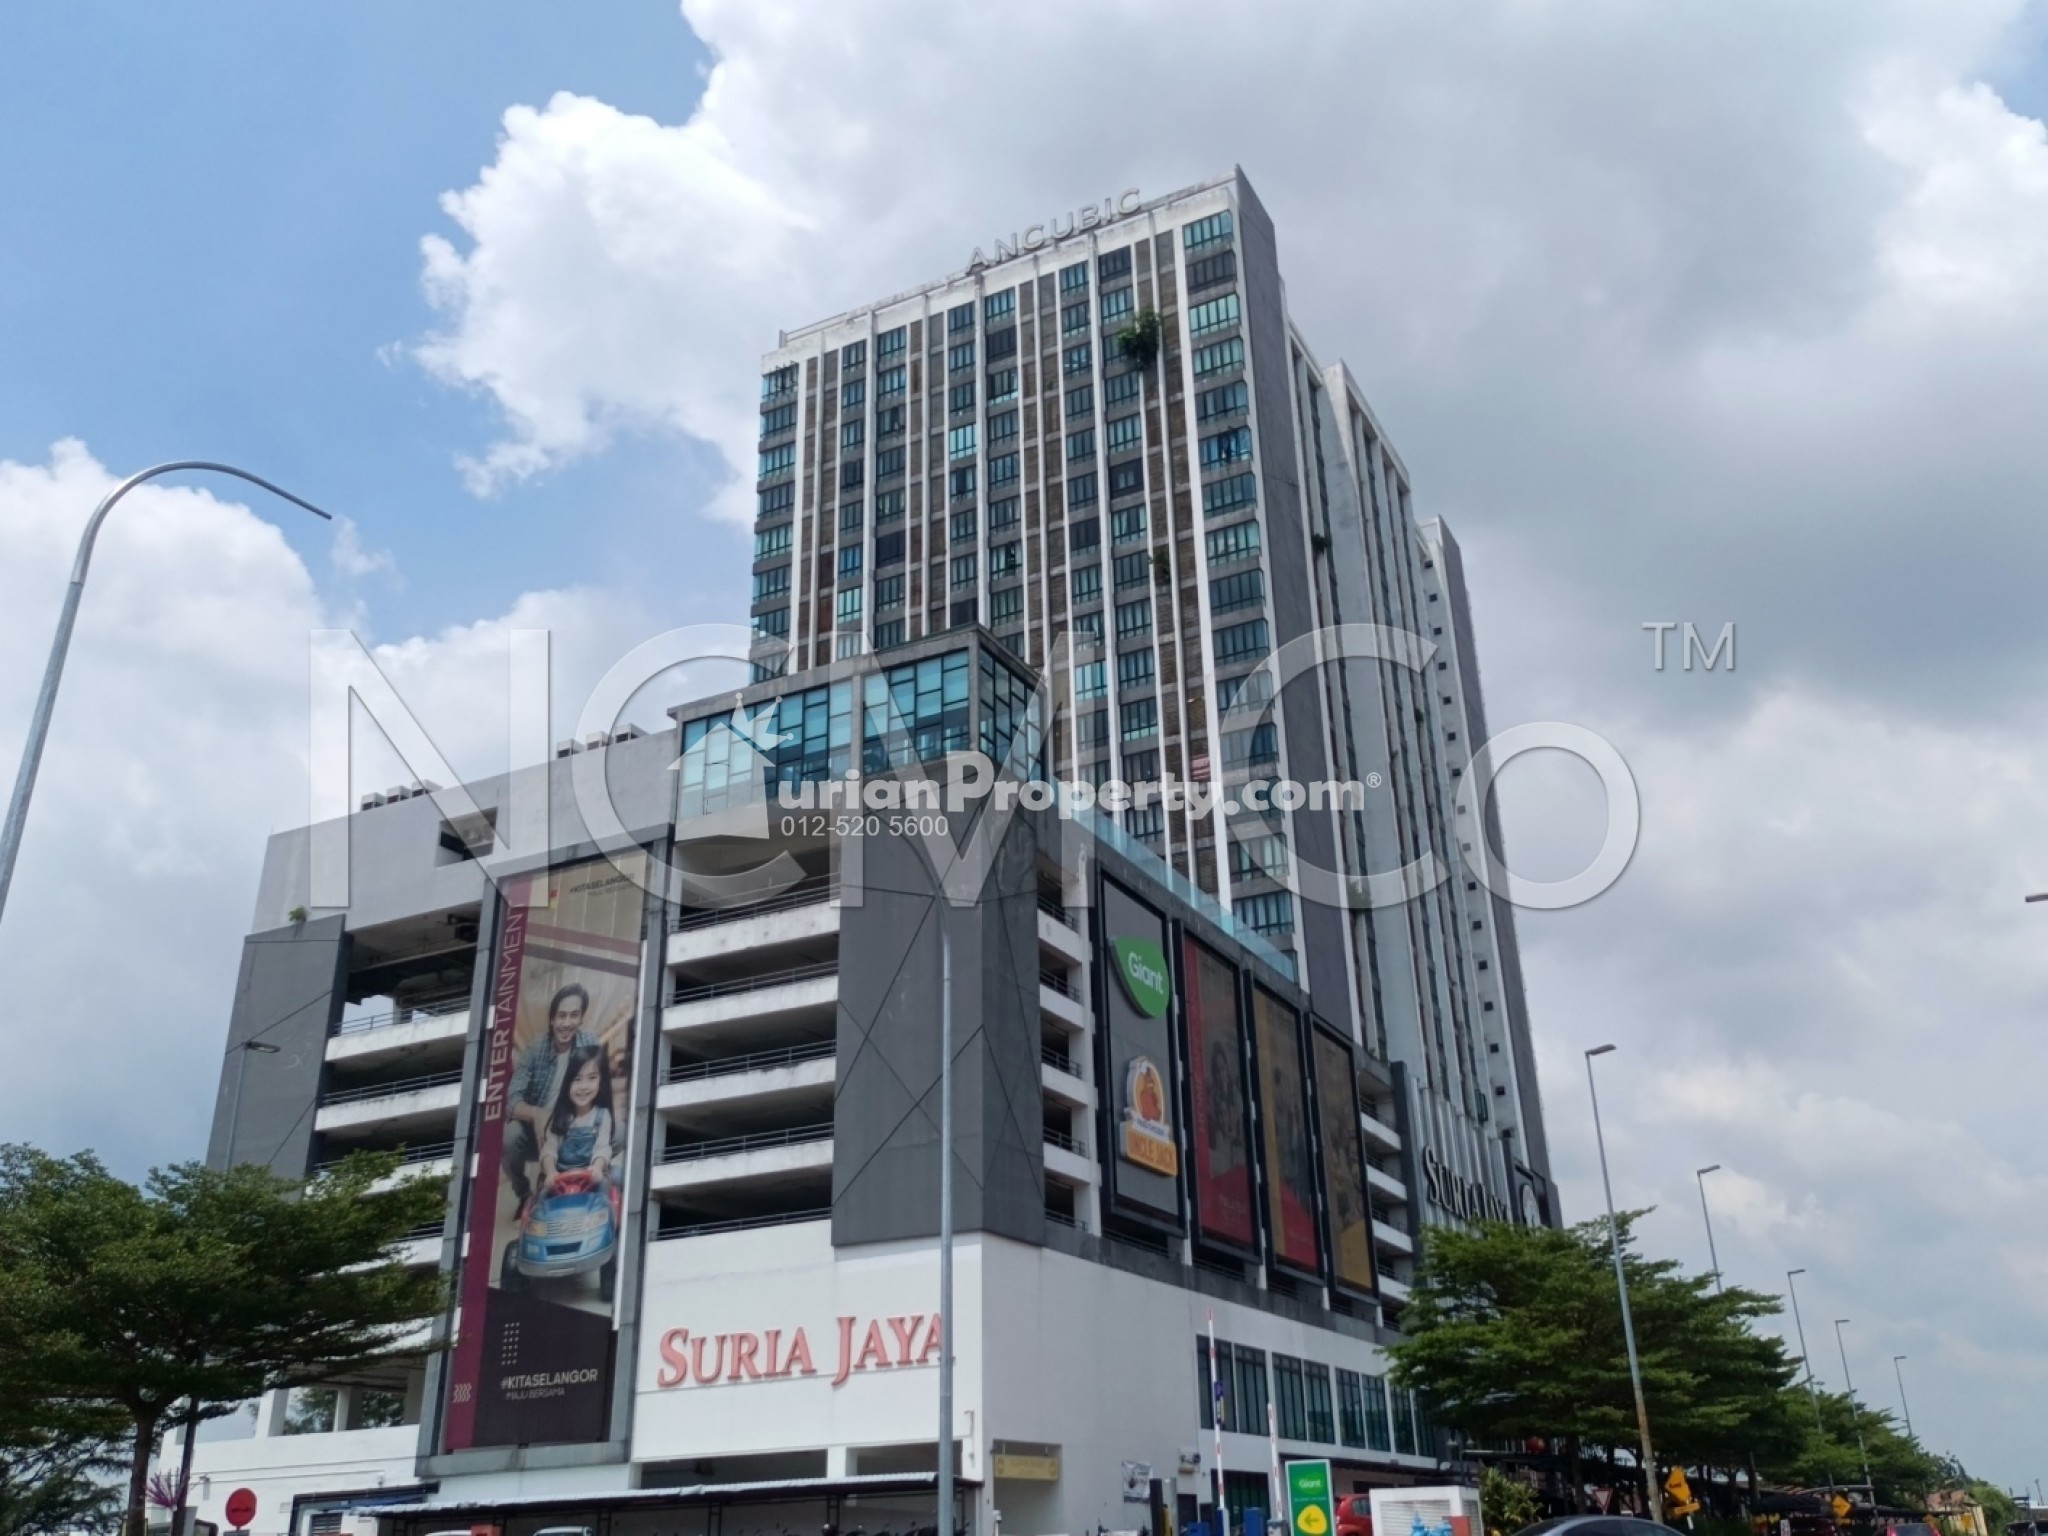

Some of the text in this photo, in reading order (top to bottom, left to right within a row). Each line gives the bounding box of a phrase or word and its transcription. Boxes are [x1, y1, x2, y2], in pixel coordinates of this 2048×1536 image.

[966, 187, 1142, 275] ANCUBIC
[484, 899, 526, 1121] ENTERTAINMENT
[1127, 950, 1165, 997] Giant
[500, 1368, 599, 1389] #KITASELANGOR
[656, 1312, 955, 1389] SURIA JAYA
